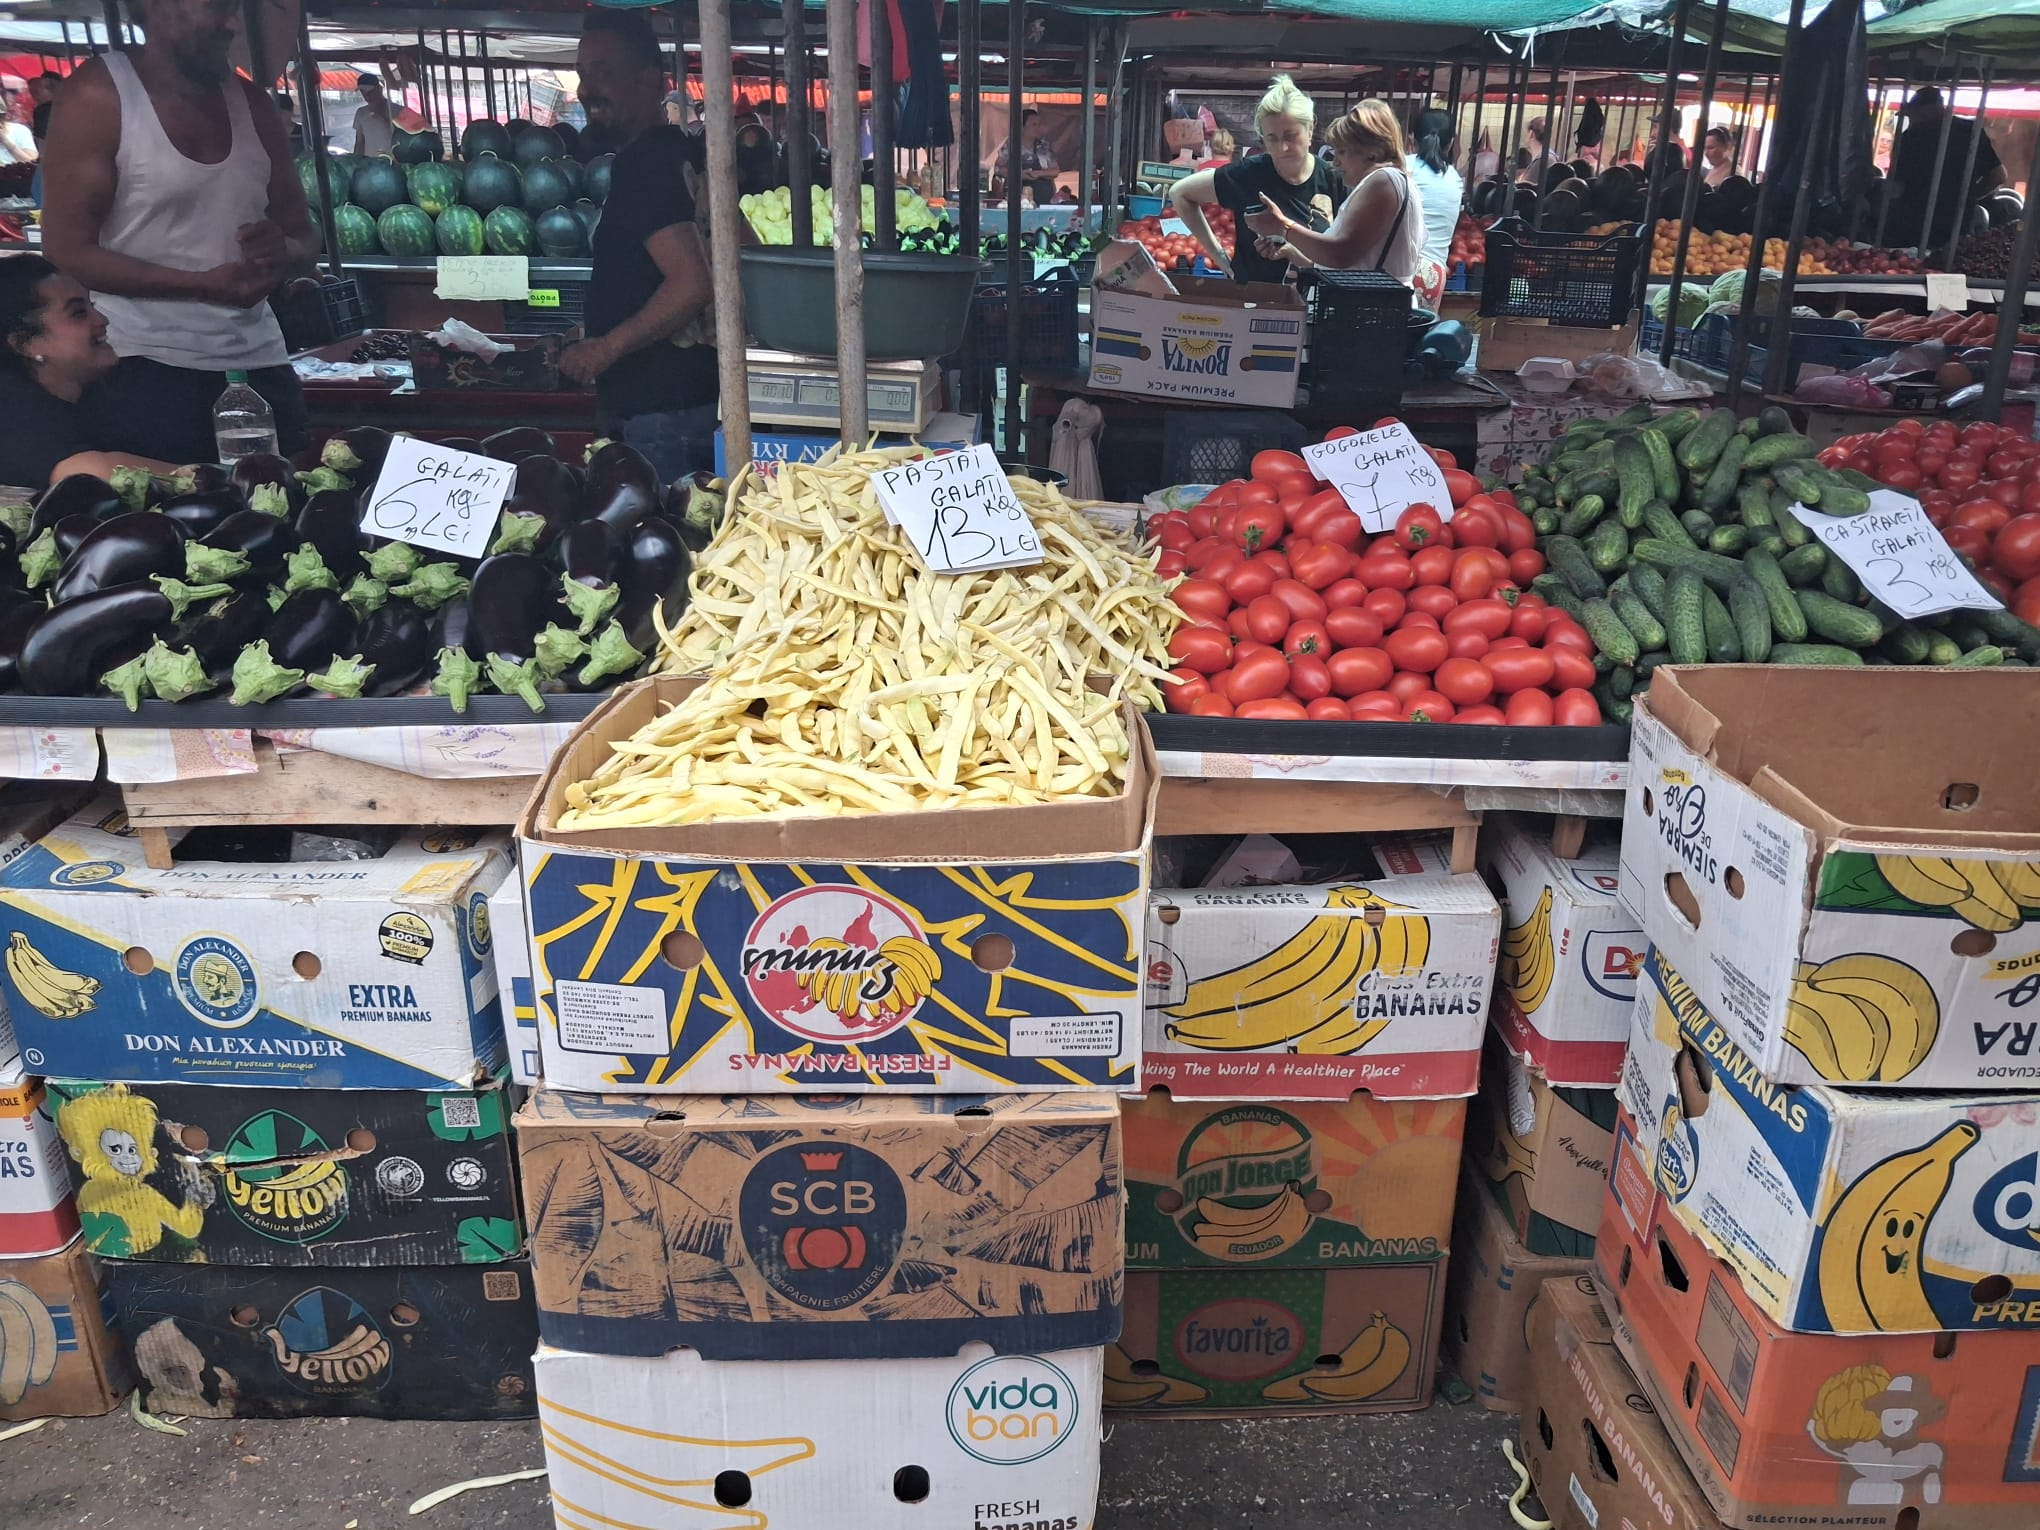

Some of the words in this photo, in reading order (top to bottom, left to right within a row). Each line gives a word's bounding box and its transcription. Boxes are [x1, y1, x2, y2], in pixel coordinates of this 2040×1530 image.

[1163, 326, 1196, 336] BANANAS
[1200, 330, 1233, 338] PREMIUM
[1161, 339, 1230, 376] BONITA
[1147, 380, 1177, 392] PACK
[1181, 384, 1235, 398] PREMIUM
[1312, 426, 1402, 459] GOGONELE
[374, 478, 418, 529] 6
[925, 506, 995, 569] 13
[1658, 809, 1718, 885] SIEMBRA
[1700, 831, 1712, 849] DE
[1193, 893, 1245, 901] Class
[1252, 892, 1305, 900] Extra
[1195, 898, 1310, 906] BANANAS
[388, 929, 426, 946] 100%
[179, 951, 195, 970] DON
[194, 941, 249, 972] ALEXANDER
[740, 948, 897, 1002] Emmis
[1426, 972, 1484, 990] Extra
[348, 984, 418, 1008] EXTRA
[1355, 991, 1483, 1020] BANANAS
[340, 1010, 385, 1022] PREMIUM
[387, 1010, 432, 1023] BANANAS
[124, 1034, 181, 1052] DON
[188, 1036, 347, 1057] ALEXANDER
[728, 1053, 860, 1073] BANANAS
[866, 1054, 952, 1073] FRESH
[1184, 1062, 1211, 1077] The
[1217, 1062, 1259, 1077] World
[1266, 1063, 1276, 1076] A
[1284, 1063, 1357, 1079] Healthier
[1702, 1026, 1809, 1134] BANANAS
[1220, 1111, 1281, 1125] BANANAS
[1184, 1167, 1224, 1199] DON
[1224, 1143, 1312, 1196] JORGE
[223, 1166, 348, 1219] yellow
[770, 1180, 876, 1216] SCB
[242, 1211, 290, 1232] PREMIUM
[294, 1210, 337, 1233] BANANAS
[1229, 1236, 1283, 1255] ECUADOR
[1319, 1237, 1438, 1260] BANANAS
[1972, 1302, 2040, 1323] PRE
[1185, 1320, 1293, 1357] favorita
[266, 1328, 390, 1384] yellow
[963, 1377, 1058, 1411] vida
[967, 1408, 1059, 1441] ban
[1603, 1417, 1675, 1526] BANANAS
[974, 1499, 1040, 1520] FRESH
[1745, 1512, 1818, 1525] SÉLECTION
[1821, 1516, 1887, 1526] PLANTEUR
